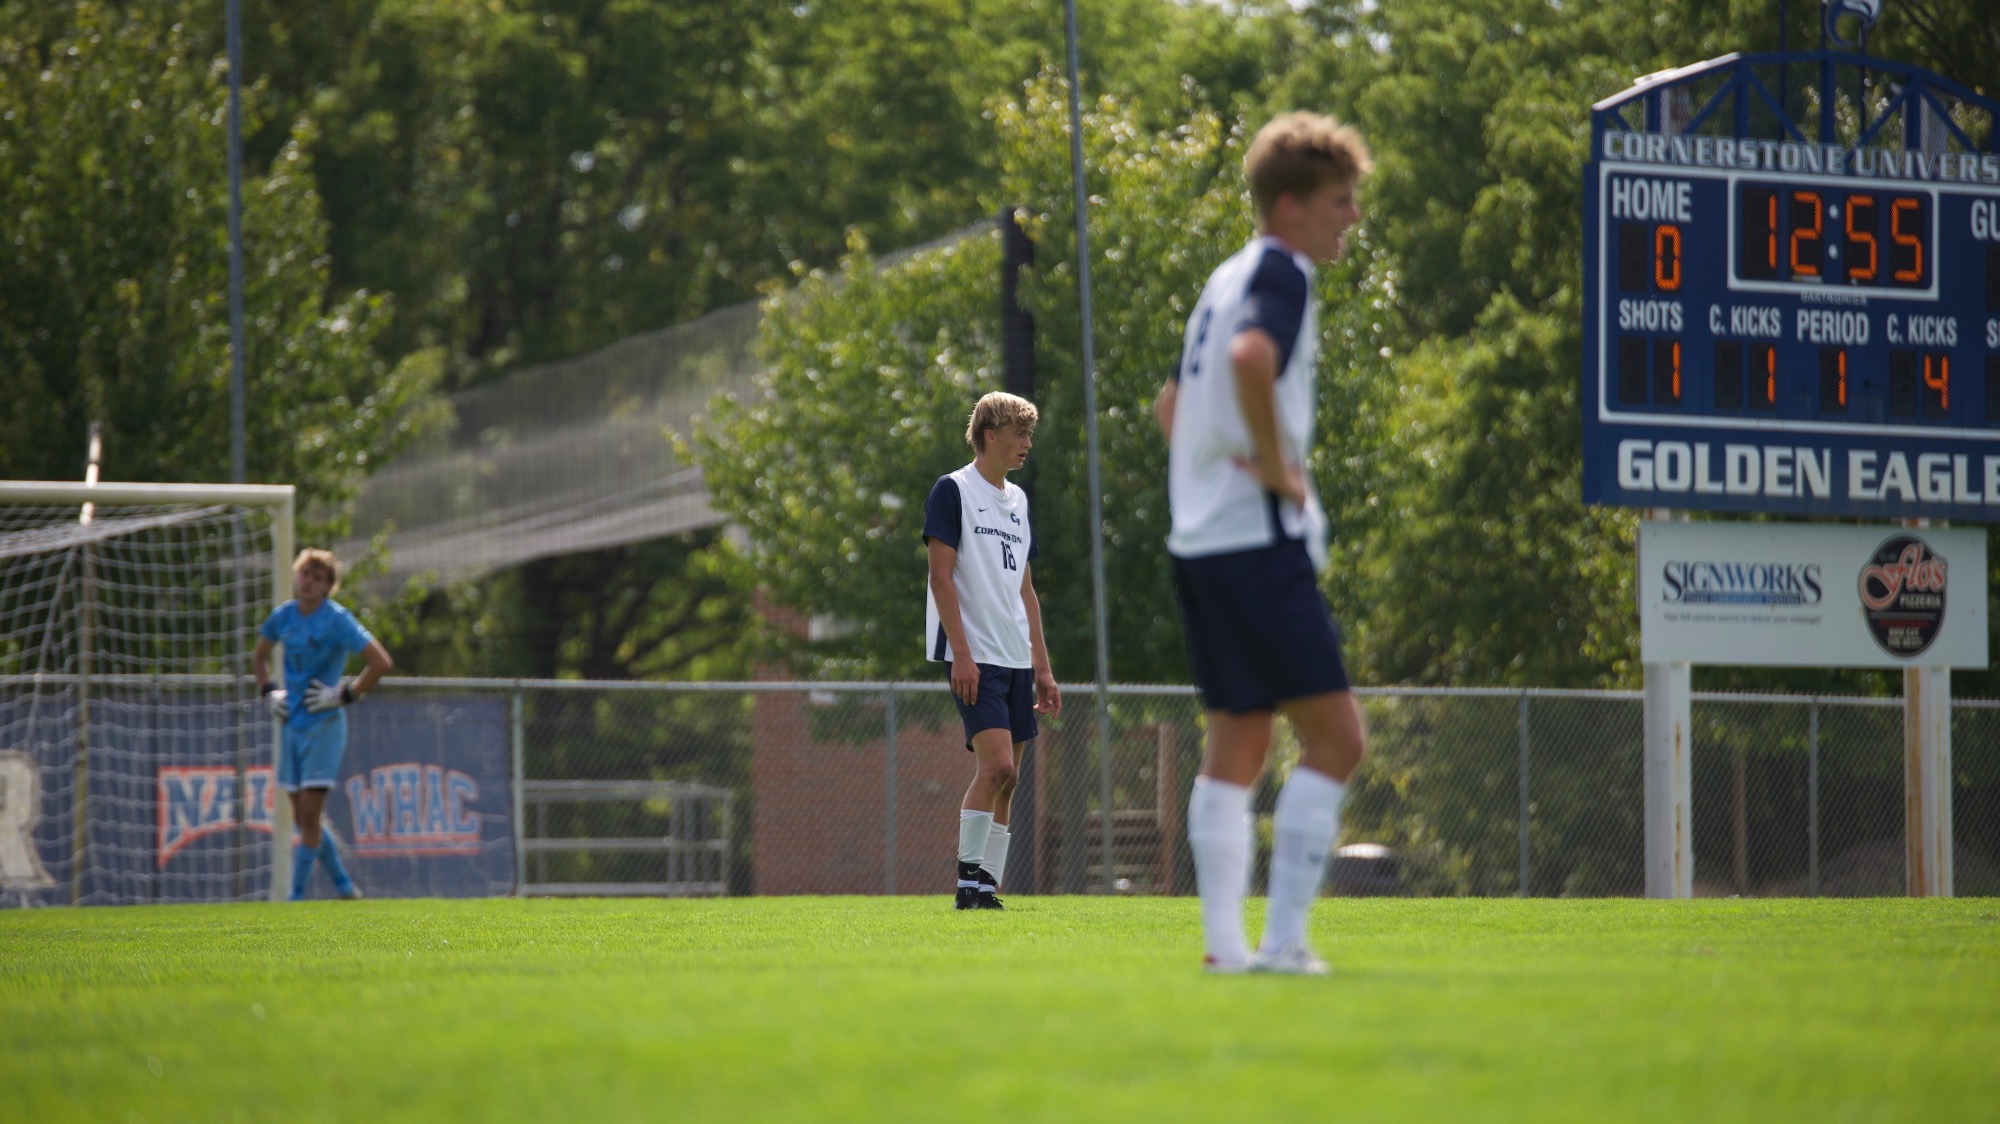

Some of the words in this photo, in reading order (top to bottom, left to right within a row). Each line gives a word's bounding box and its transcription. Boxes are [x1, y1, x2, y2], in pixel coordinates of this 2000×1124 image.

[1603, 130, 1845, 176] CORNERSTONE
[1612, 178, 1692, 222] HOME
[1654, 224, 1681, 290] 0
[1619, 299, 1683, 332] SHOTS
[1709, 304, 1726, 335] C.
[1730, 306, 1782, 338] KICKS
[1796, 308, 1870, 345] PERIOD
[1886, 315, 1905, 344] C.
[1907, 316, 1958, 347] KICKS
[1670, 340, 1682, 400] 1
[1765, 346, 1777, 405] 1
[1836, 349, 1847, 407] 1
[1922, 353, 1950, 412] 4
[1617, 438, 1832, 498] GOLDEN
[1000, 540, 1017, 571] 18
[1662, 560, 1823, 607] SIGNWORKS
